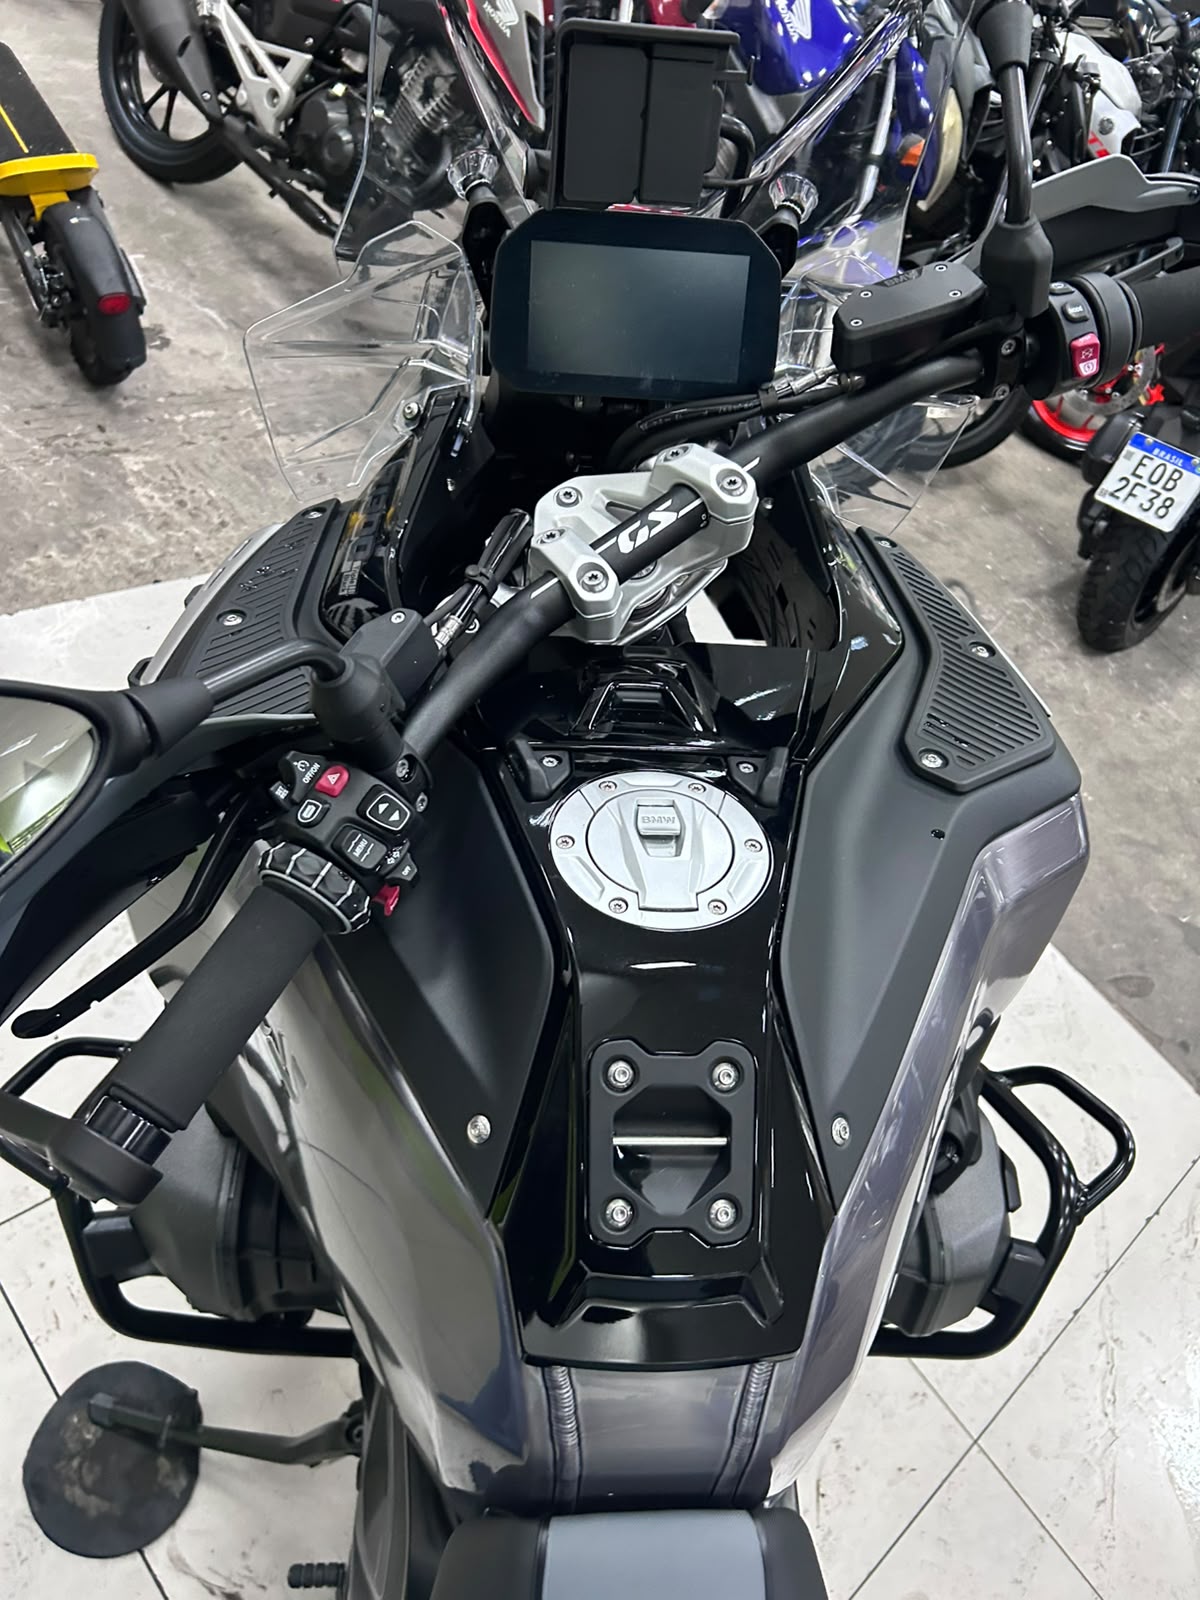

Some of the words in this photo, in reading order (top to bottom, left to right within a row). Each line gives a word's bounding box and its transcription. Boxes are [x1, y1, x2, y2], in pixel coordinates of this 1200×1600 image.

[482, 0, 511, 38] HONDA
[1152, 447, 1184, 467] BRASIL
[1108, 476, 1175, 519] 2F38
[617, 498, 678, 554] GS
[302, 762, 321, 784] OFF/ON
[641, 815, 676, 824] BMW
[352, 838, 369, 858] MENU
[401, 865, 411, 876] OFF
